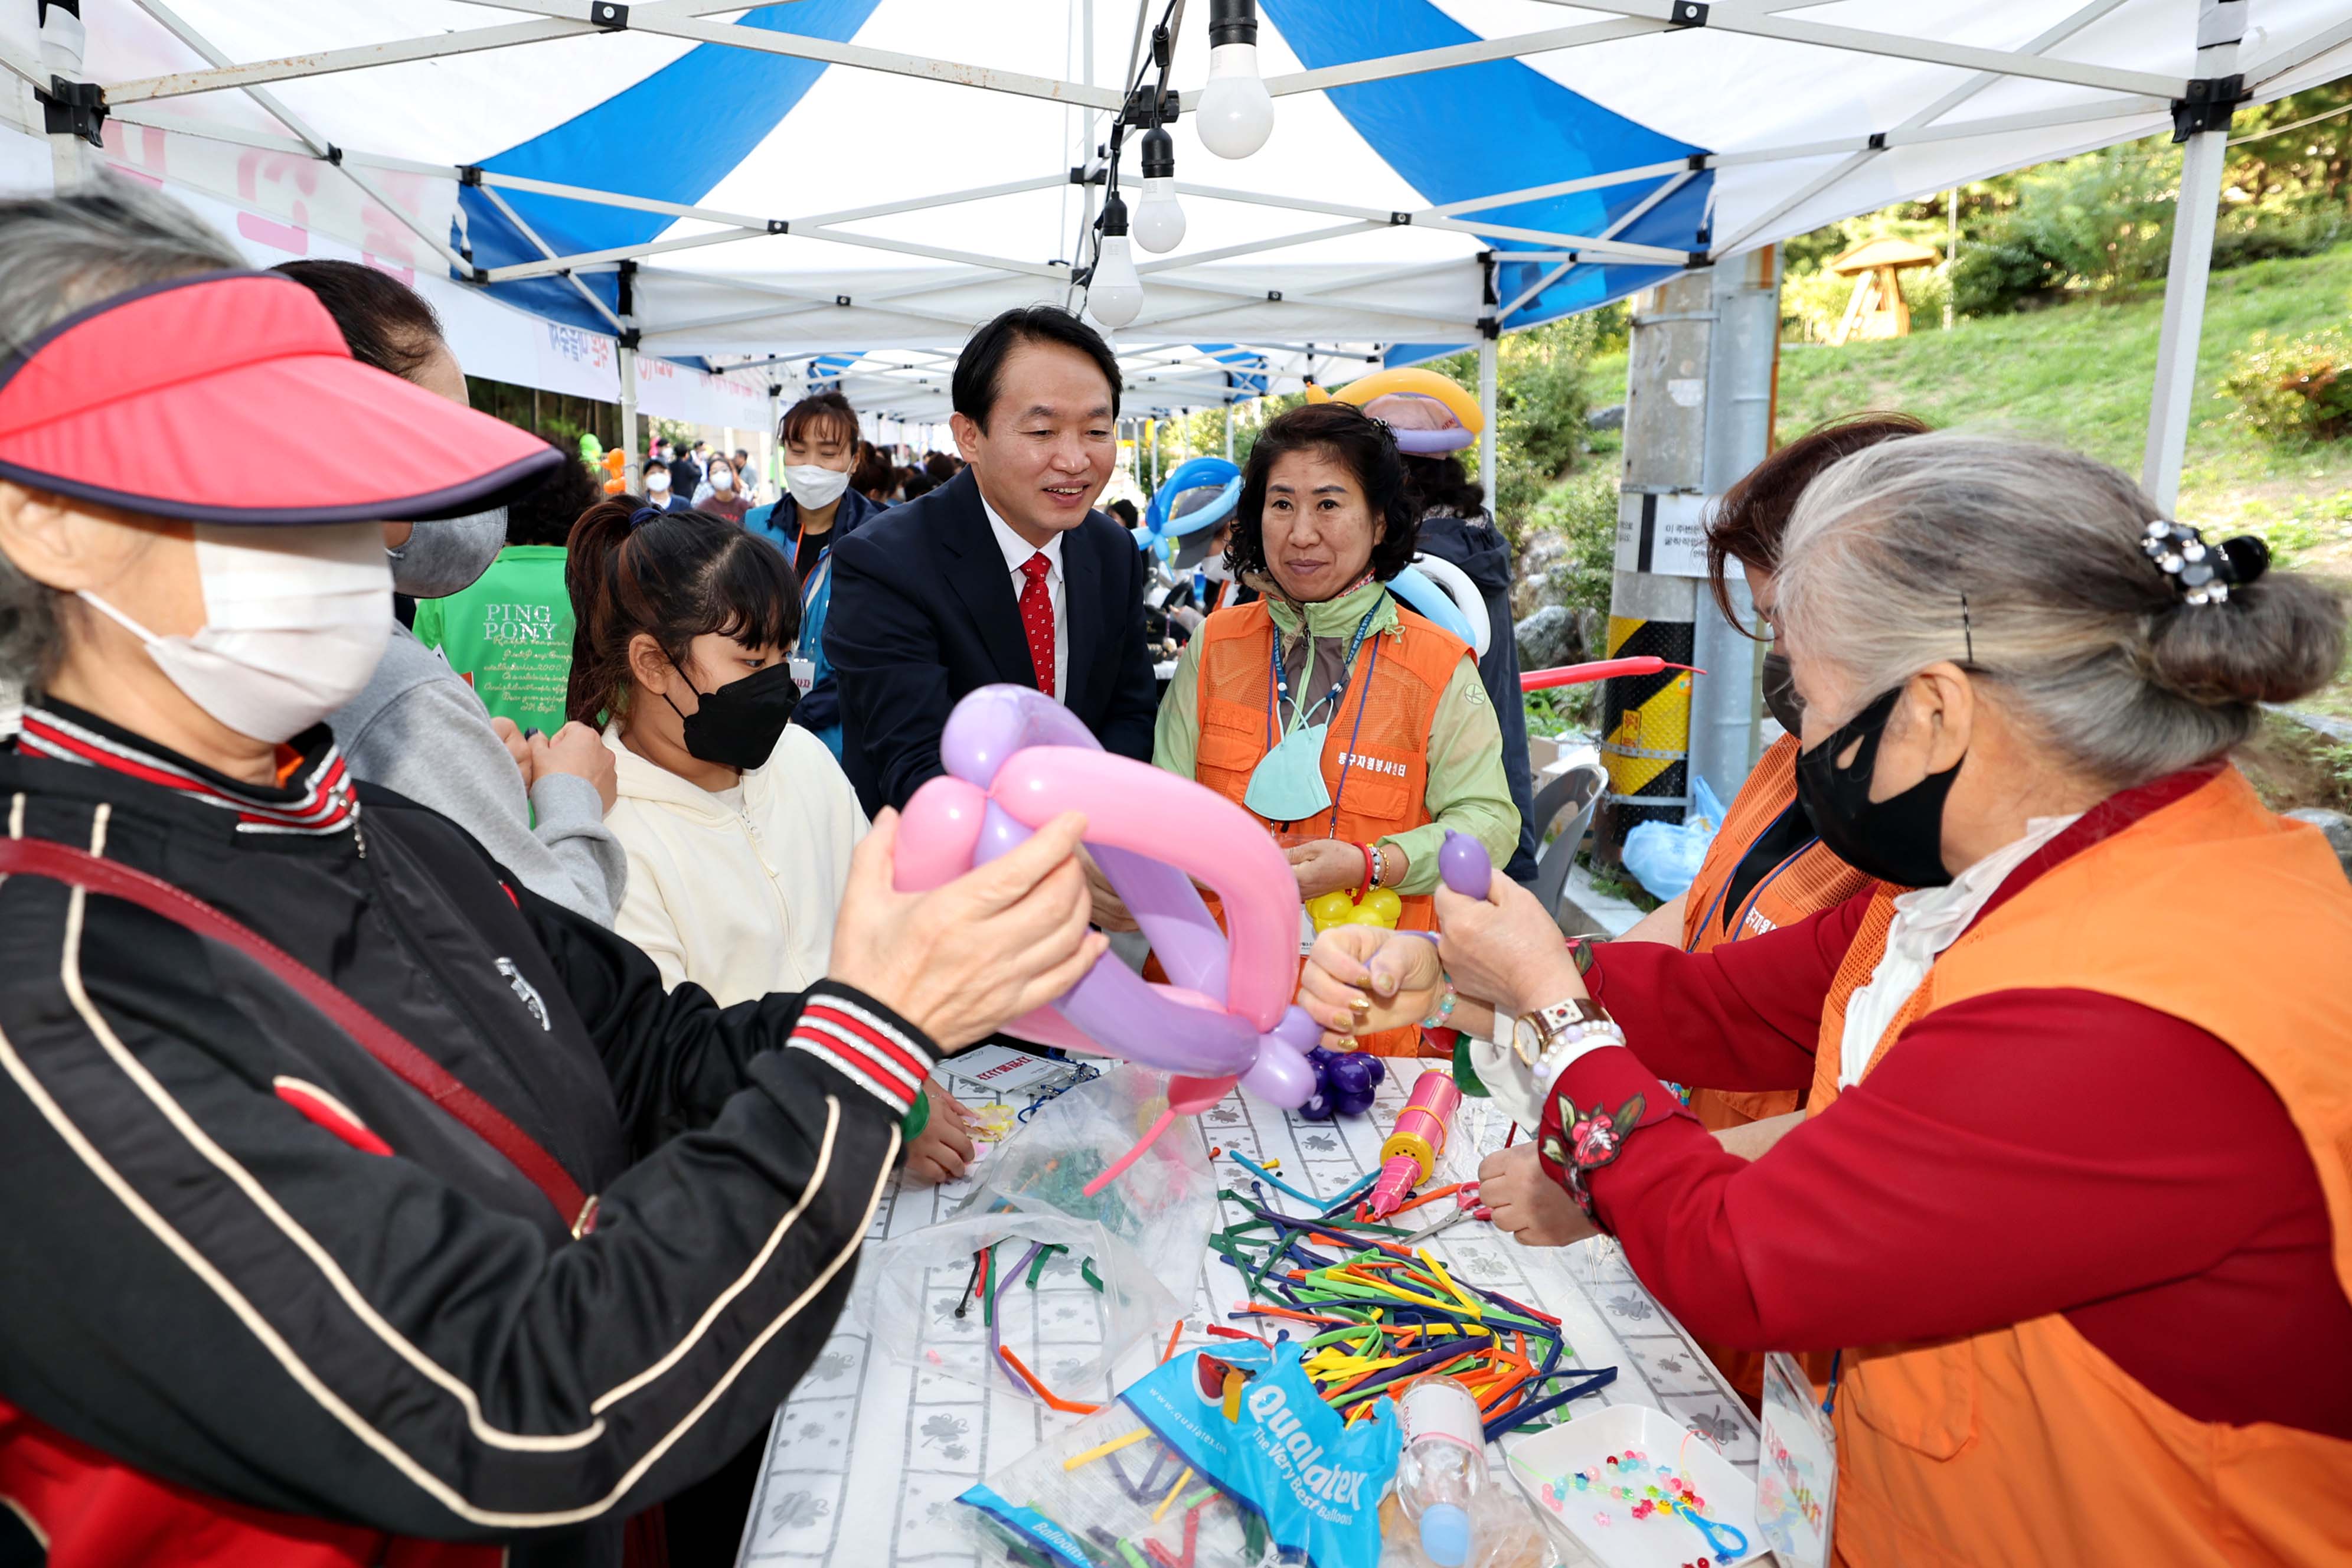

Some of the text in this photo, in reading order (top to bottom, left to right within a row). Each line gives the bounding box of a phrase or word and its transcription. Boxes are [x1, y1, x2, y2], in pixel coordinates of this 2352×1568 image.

[485, 604, 551, 622] PING
[483, 621, 557, 640] PONY
[1338, 752, 1406, 778] 동구자원봉사센터
[975, 1056, 1033, 1081] 자원봉사자
[1248, 1385, 1368, 1511] Qualatex
[1252, 1425, 1270, 1451] The
[1268, 1442, 1296, 1481] Very
[1289, 1476, 1321, 1510] Best
